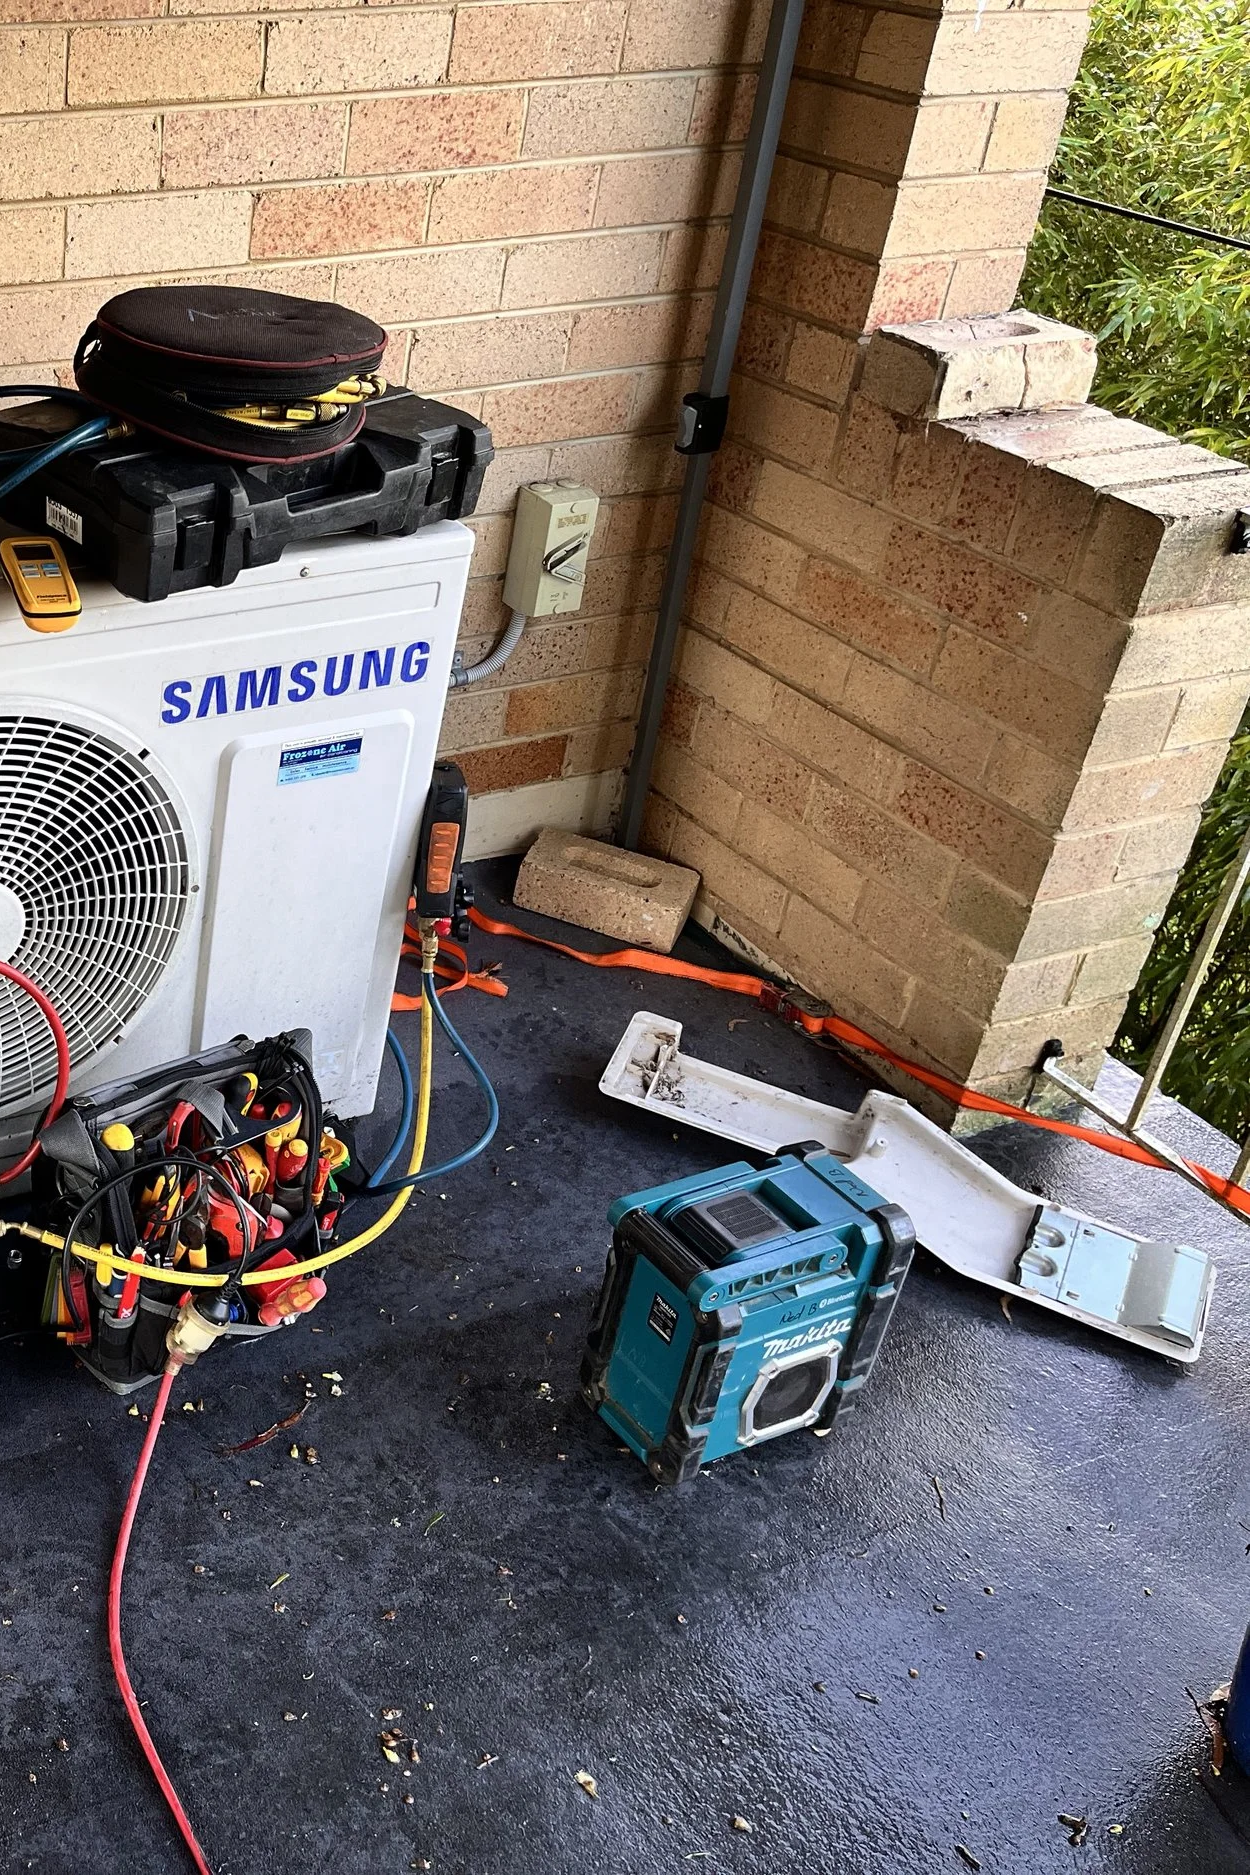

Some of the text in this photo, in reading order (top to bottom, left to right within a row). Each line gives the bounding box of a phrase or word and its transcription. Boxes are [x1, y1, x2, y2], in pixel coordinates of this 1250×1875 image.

[161, 641, 431, 724] SAMSUNG
[328, 743, 347, 753] Air
[779, 1303, 818, 1325] Ned B
